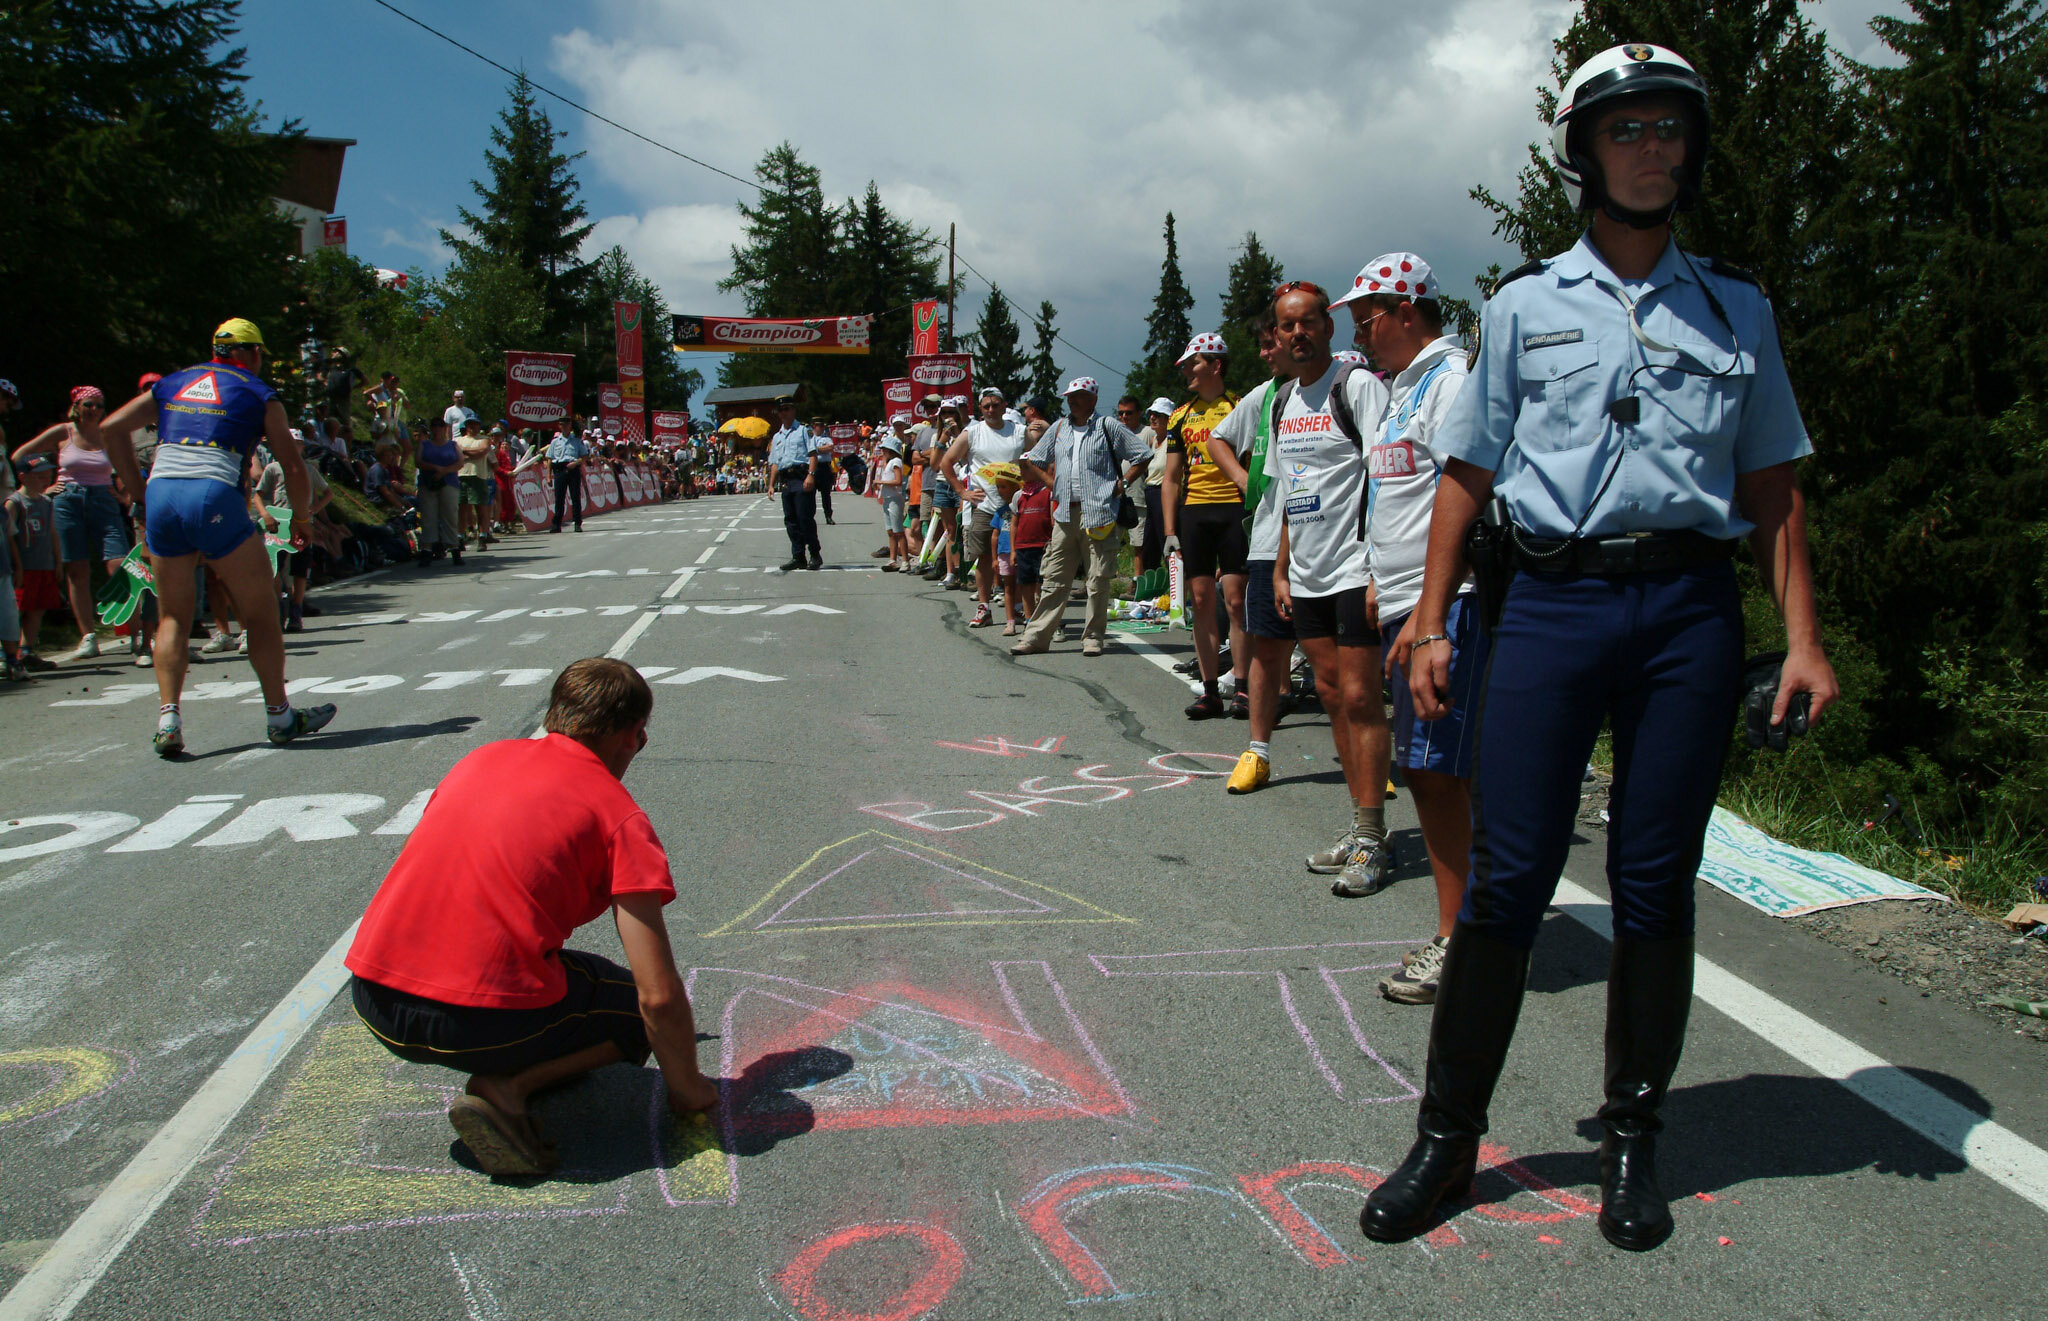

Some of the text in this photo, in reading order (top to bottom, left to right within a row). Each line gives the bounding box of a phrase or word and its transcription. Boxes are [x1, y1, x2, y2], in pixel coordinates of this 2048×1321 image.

[715, 322, 815, 342] Champion
[1525, 331, 1580, 346] GENDARMERIE
[511, 365, 563, 382] Champion
[914, 367, 963, 381] Champion
[510, 402, 563, 418] Champion
[1279, 415, 1332, 435] FINISHER
[1370, 446, 1412, 475] DLER
